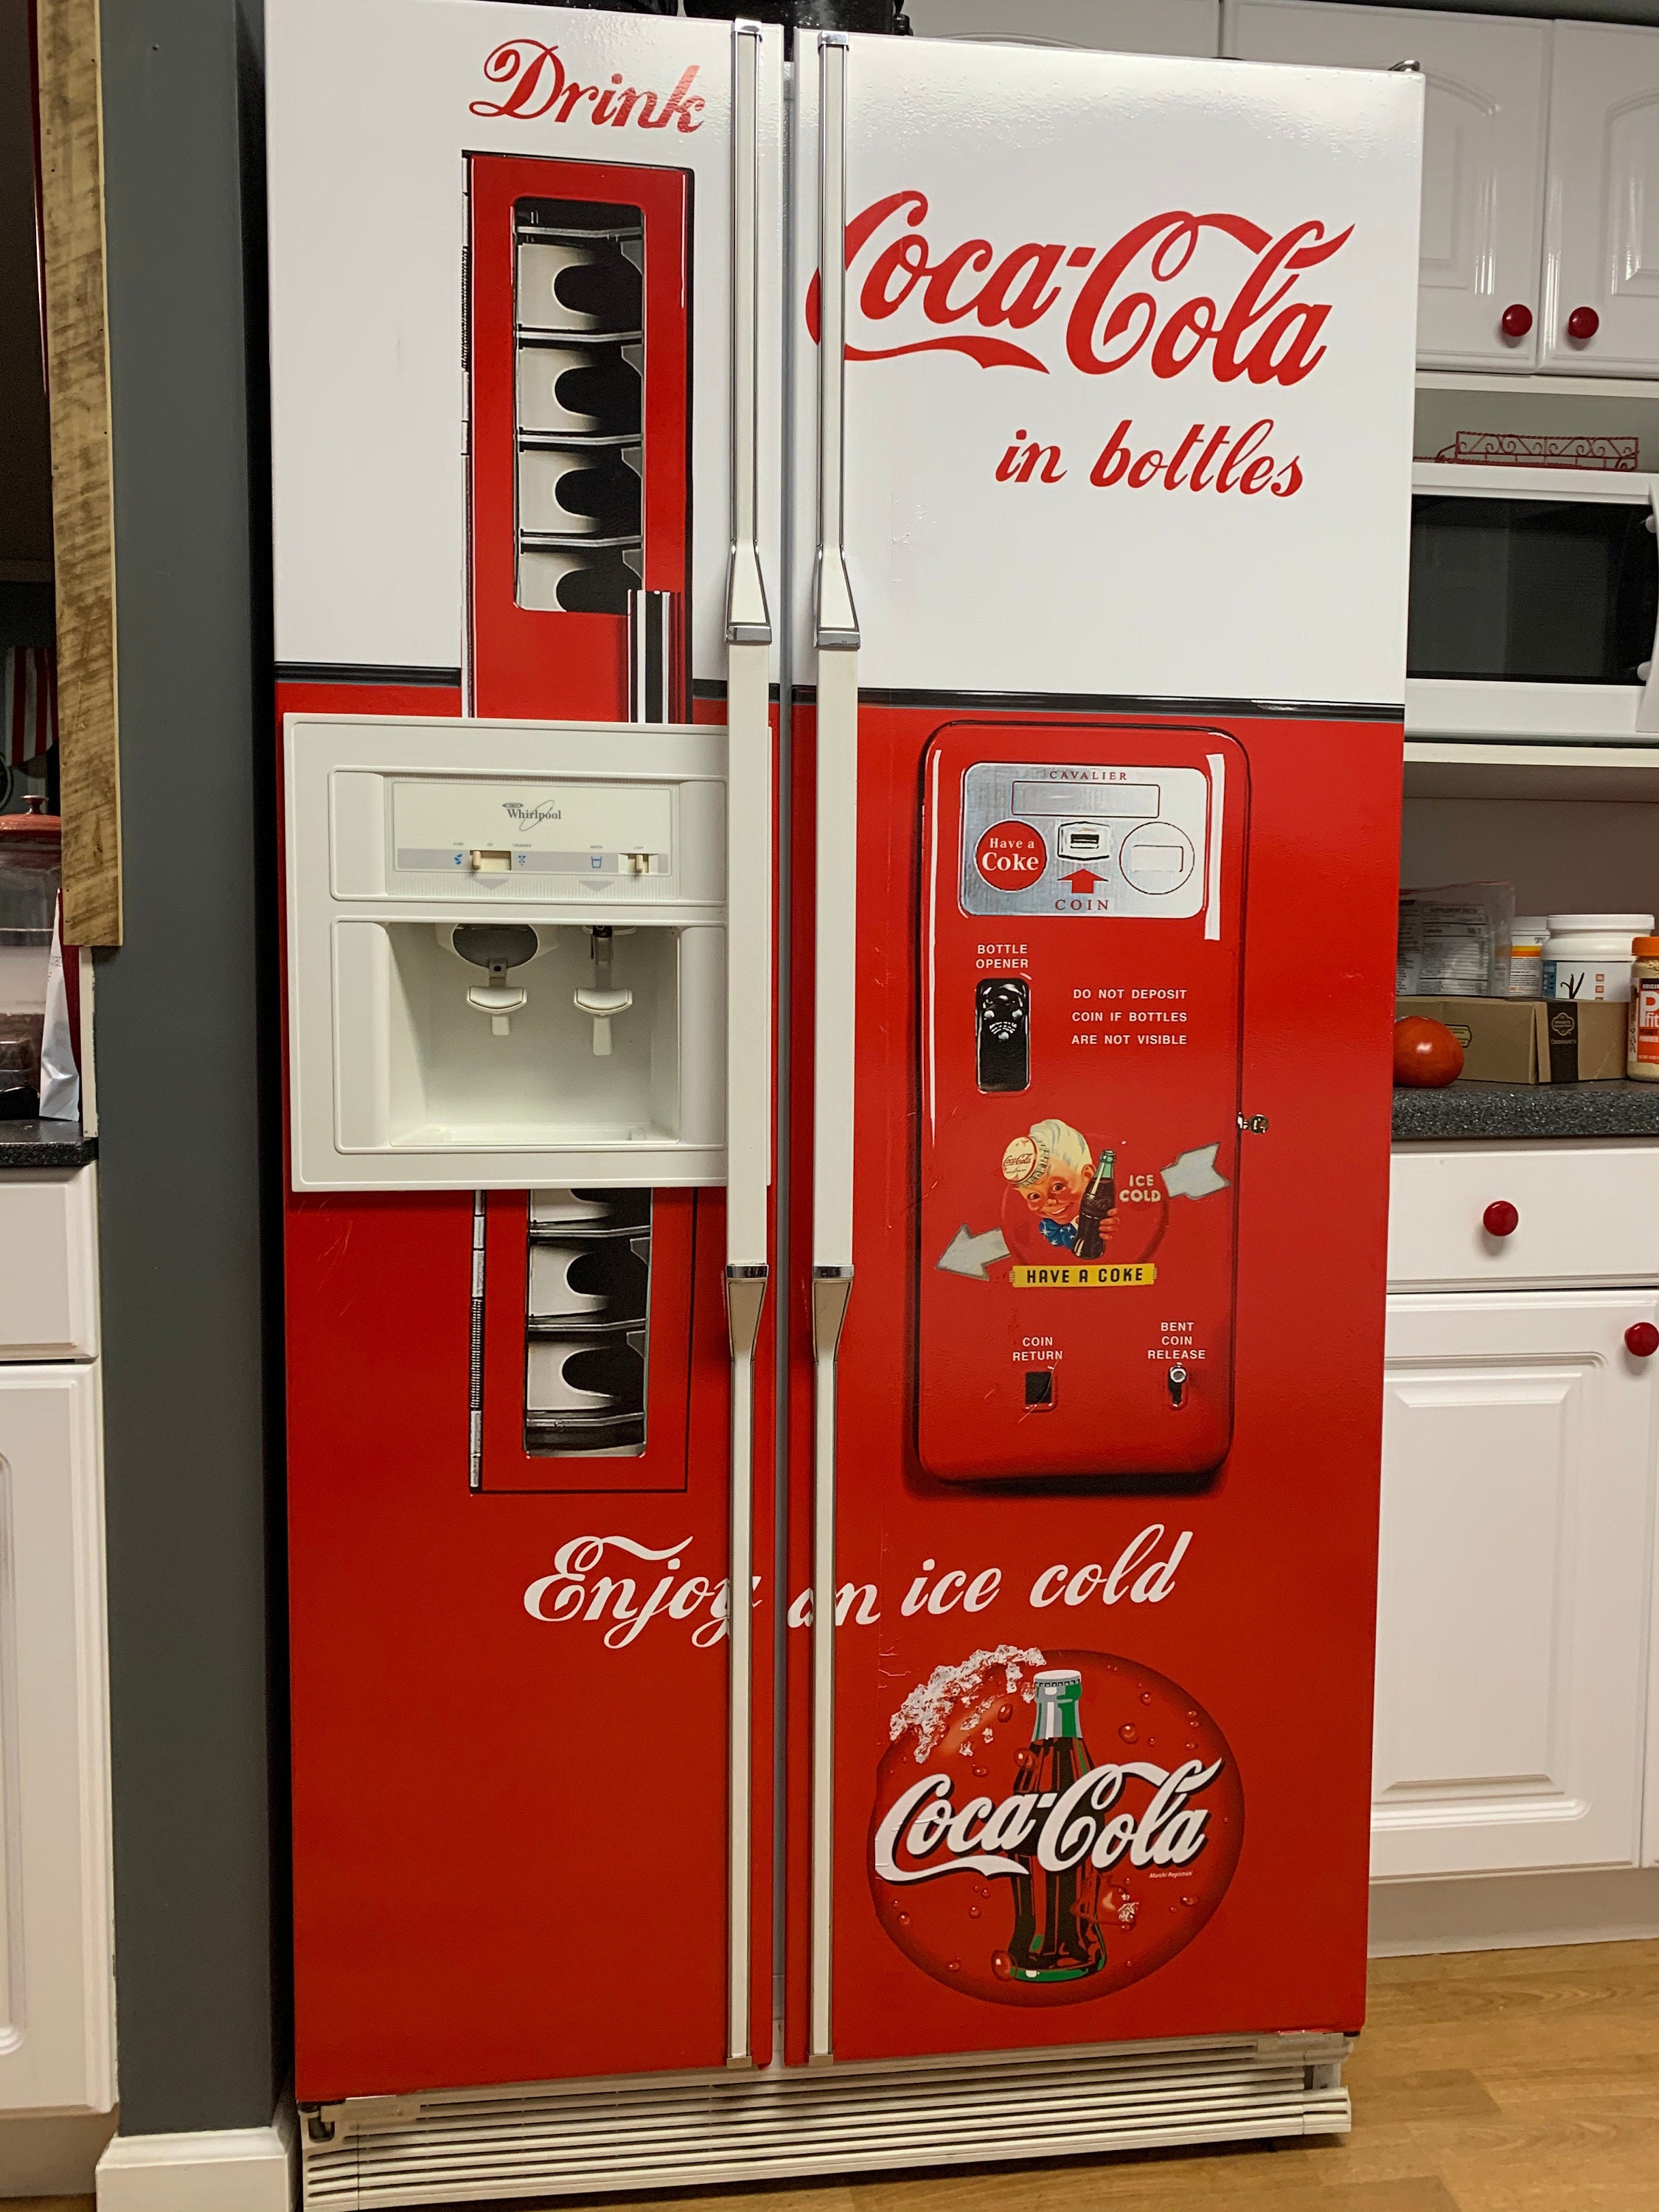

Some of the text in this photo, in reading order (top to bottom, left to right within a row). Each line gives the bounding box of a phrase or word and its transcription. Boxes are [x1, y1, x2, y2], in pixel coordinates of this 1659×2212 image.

[469, 38, 705, 133] Drink
[805, 189, 1356, 386] Coca-Cola
[995, 419, 1304, 498] in bottles
[1048, 771, 1128, 781] CAVALIER
[507, 808, 562, 822] Whirlpool
[989, 838, 1035, 849] Have a
[981, 852, 1039, 872] Coke
[1054, 899, 1110, 911] COIN
[977, 945, 1028, 954] BOTTLE
[975, 959, 1029, 968] OPENER
[1073, 989, 1187, 1000] DO NOT DEPOSIT
[1071, 1012, 1187, 1022] COIN IF BOTTLES
[1071, 1034, 1187, 1045] ARE NOT VISIBLE
[1129, 1174, 1154, 1187] ICE
[1119, 1189, 1162, 1203] COLD
[1026, 1267, 1143, 1284] HAVE A COKE
[1161, 1322, 1194, 1332] BENT
[1022, 1337, 1053, 1347] COIN
[1161, 1336, 1192, 1346] COIN
[1012, 1351, 1062, 1361] RETURN
[1147, 1350, 1206, 1360] RELEASE
[523, 1523, 1193, 1649] Enjoy an ice cold
[874, 1757, 1222, 1882] Coca-Cola
